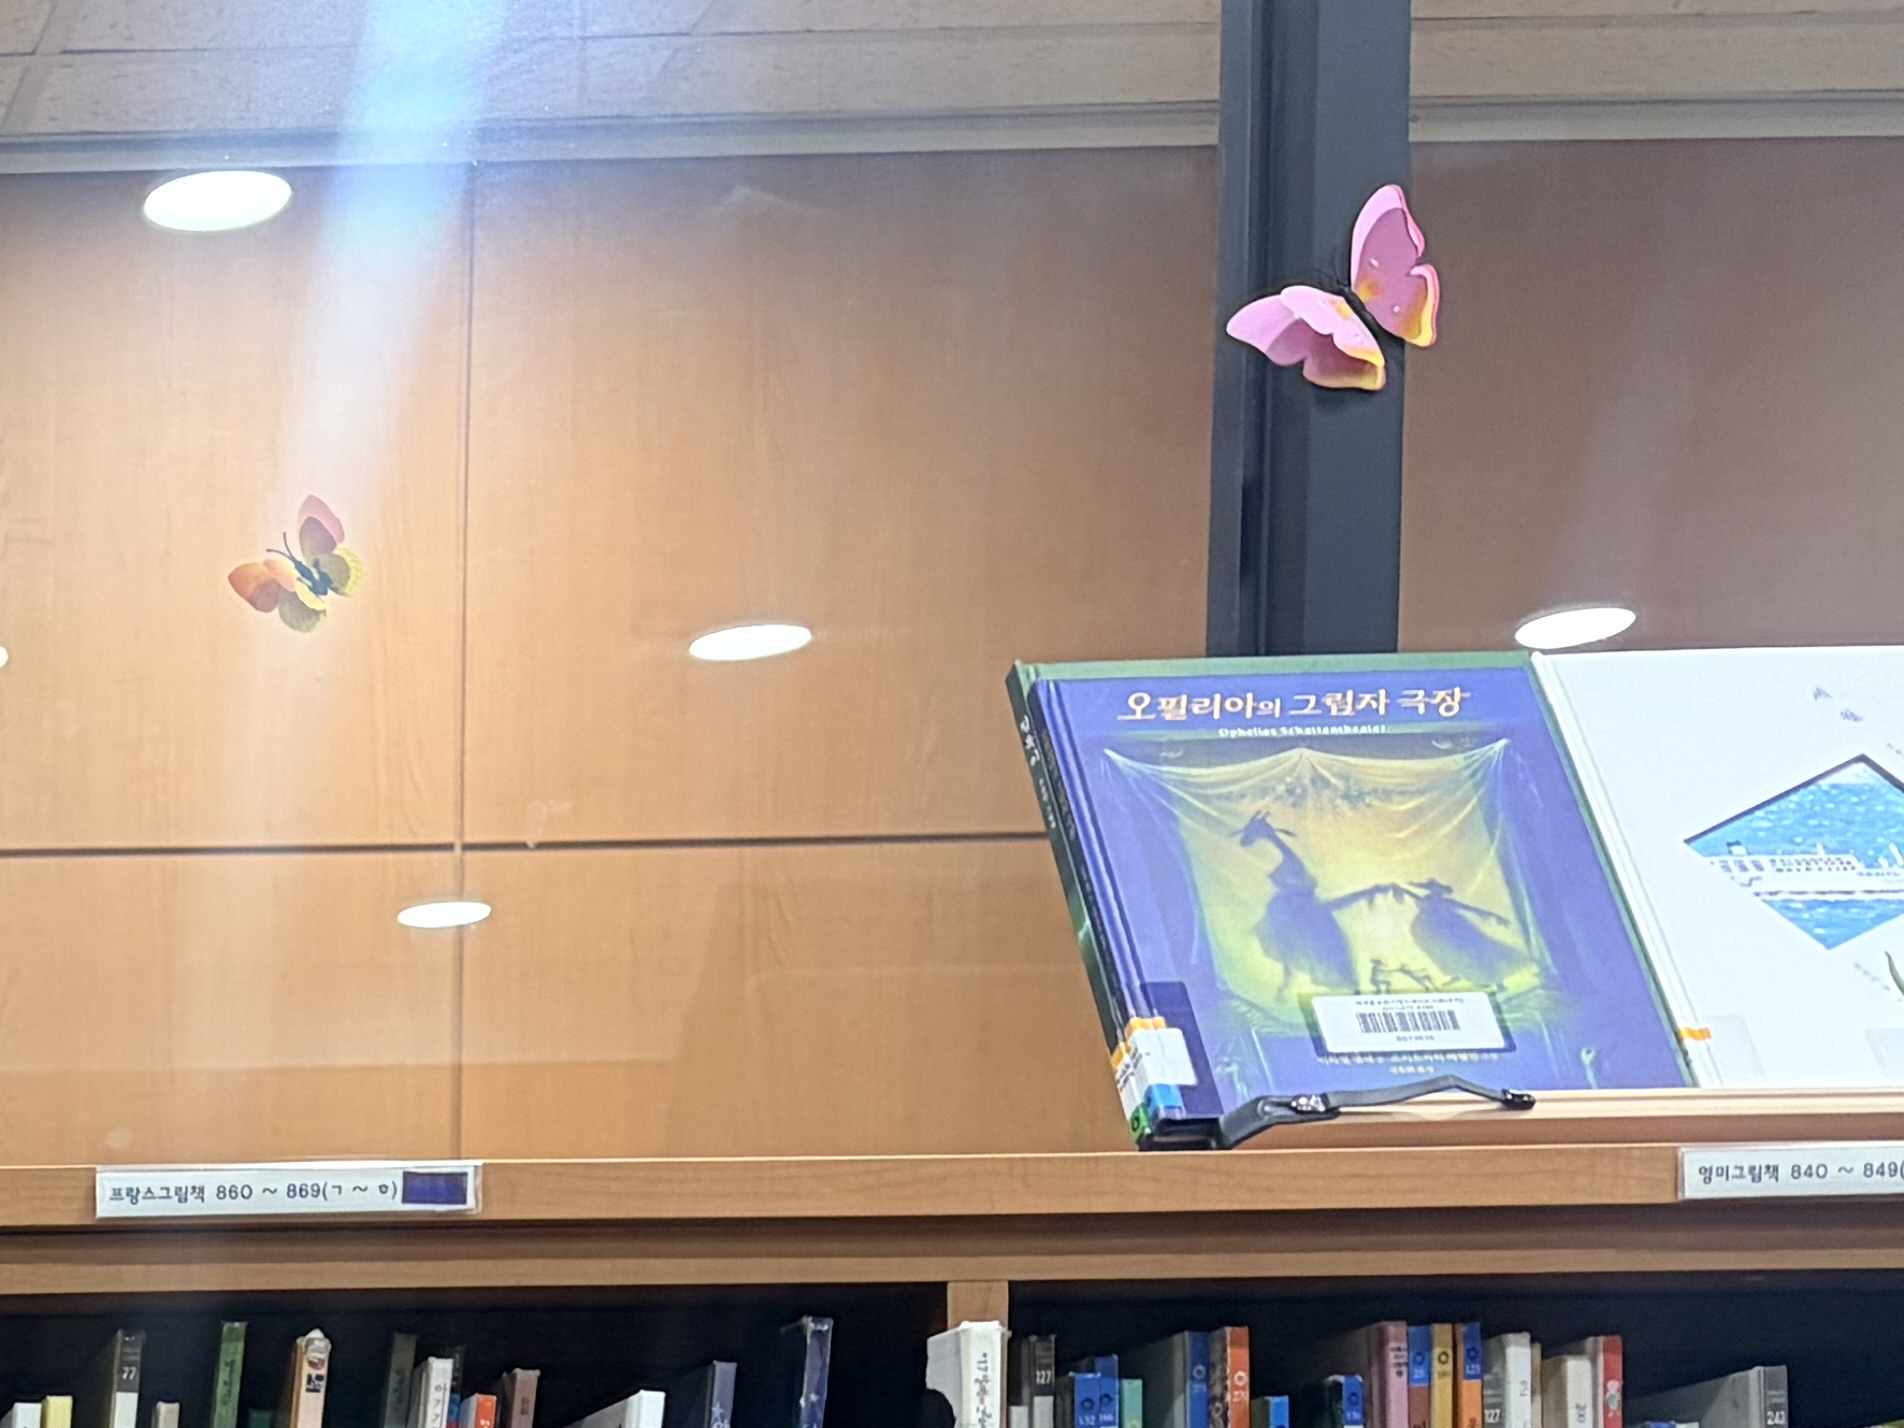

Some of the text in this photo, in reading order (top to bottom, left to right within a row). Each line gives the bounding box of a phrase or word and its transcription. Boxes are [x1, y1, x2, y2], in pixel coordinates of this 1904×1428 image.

[1116, 686, 1472, 722] 오필리아의 그림자 극장
[1698, 1163, 1780, 1185] 영미그림책
[1790, 1163, 1829, 1180] 840
[109, 1183, 205, 1206] 프랑스그림책
[215, 1183, 254, 1201] 860
